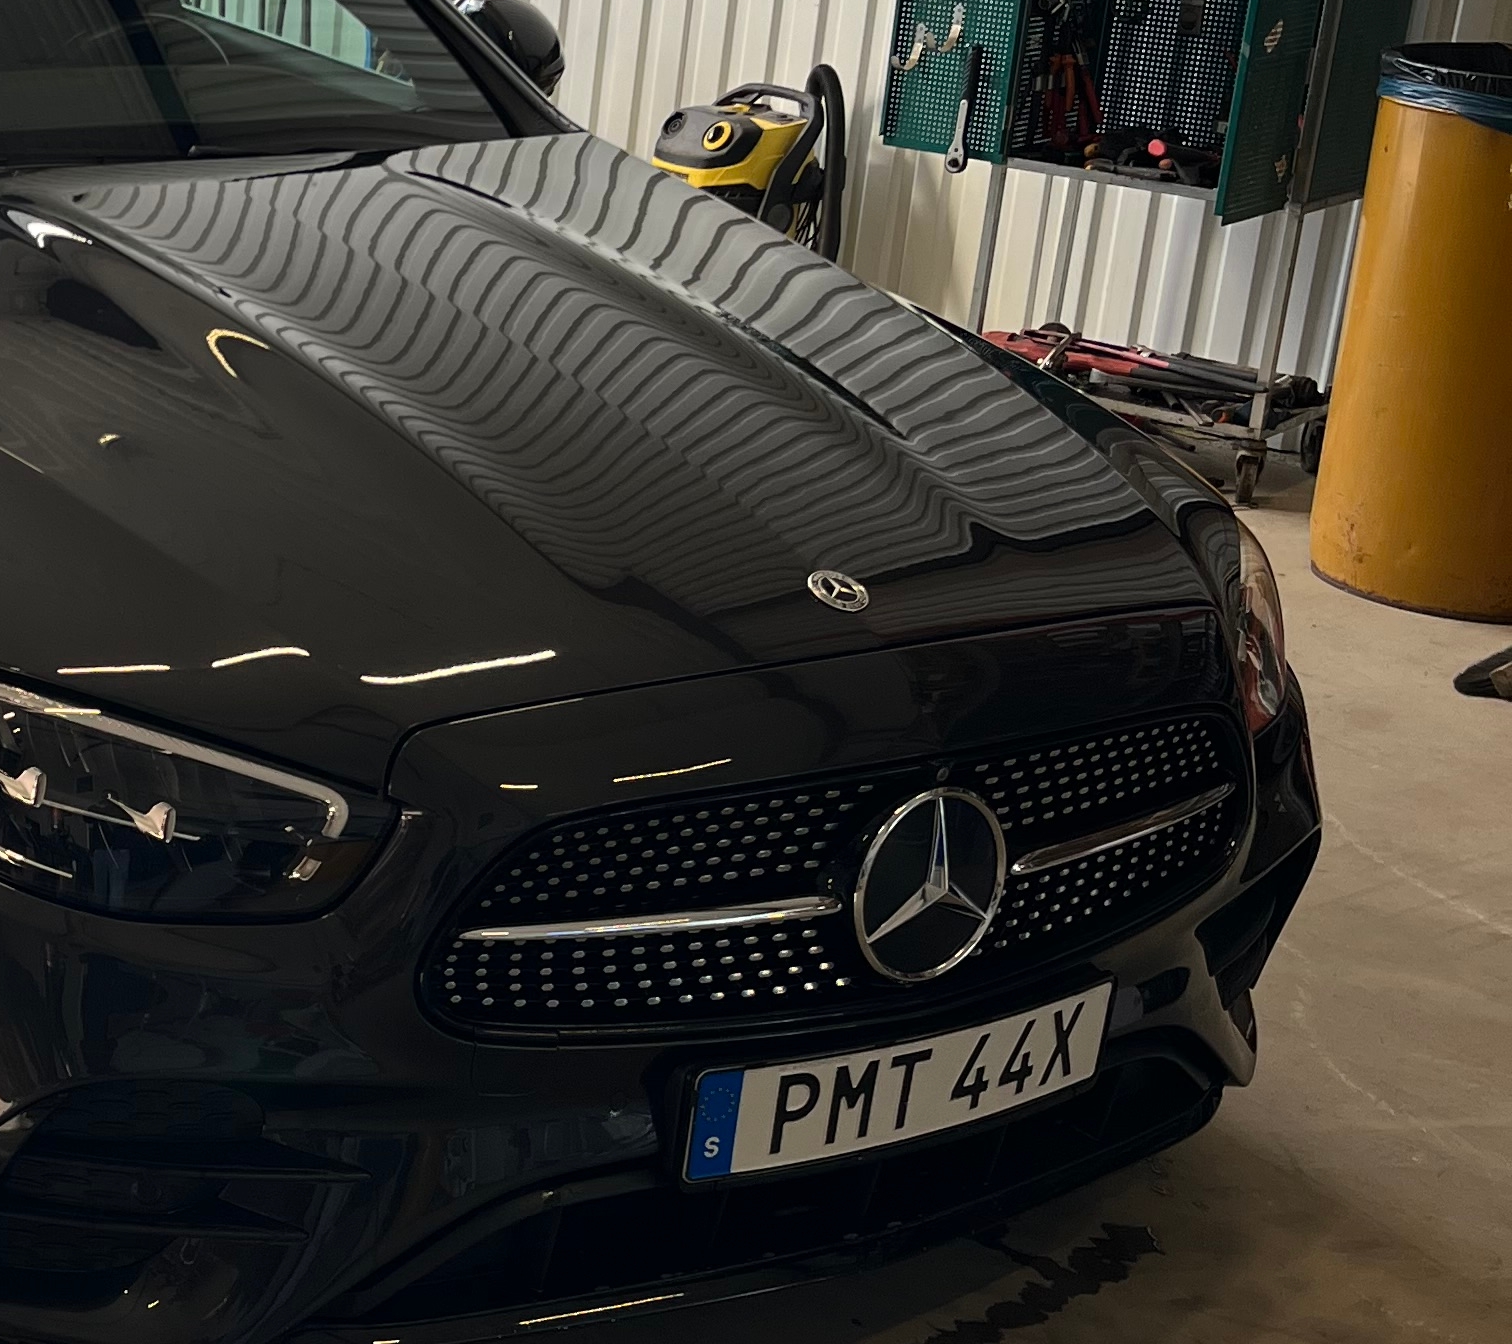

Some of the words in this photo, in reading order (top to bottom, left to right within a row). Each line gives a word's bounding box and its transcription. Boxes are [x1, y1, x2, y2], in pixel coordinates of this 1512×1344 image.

[769, 1048, 933, 1155] PMT
[949, 1001, 1085, 1110] 44X
[704, 1136, 720, 1158] S
